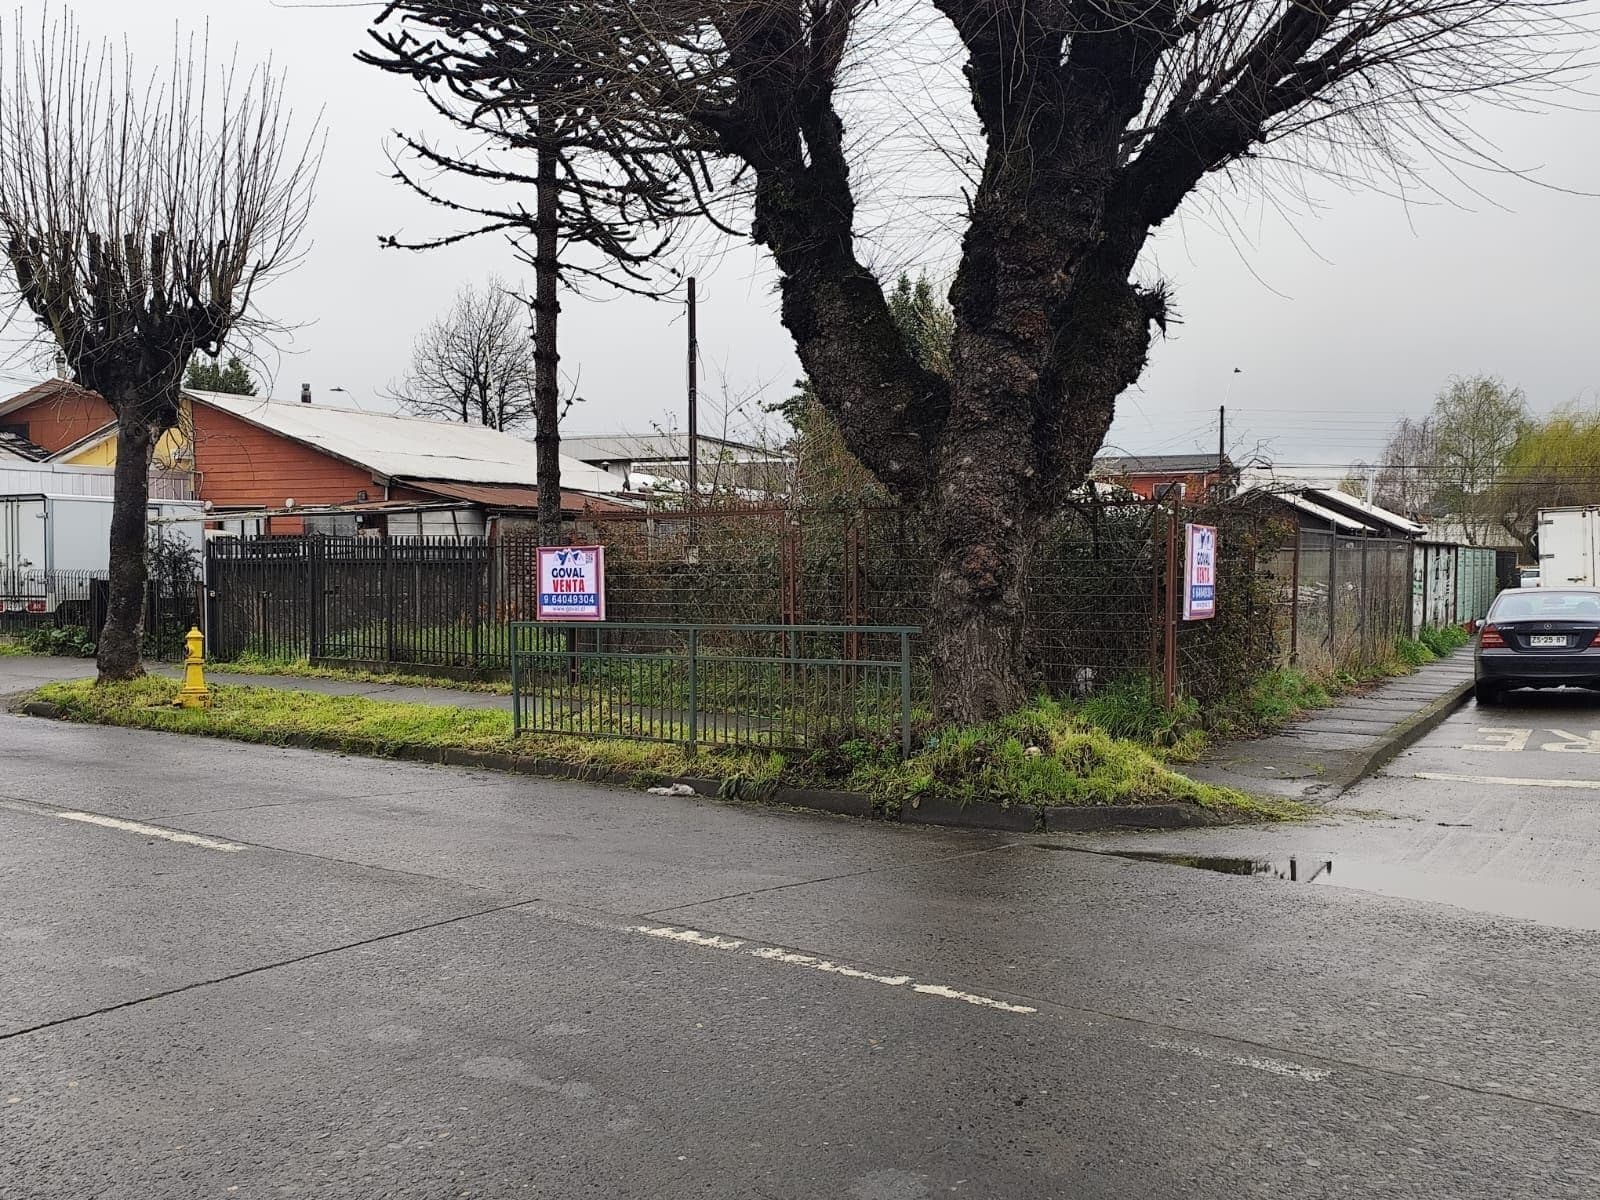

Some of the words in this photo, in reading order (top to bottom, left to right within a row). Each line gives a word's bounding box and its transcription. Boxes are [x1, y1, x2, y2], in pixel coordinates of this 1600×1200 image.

[551, 568, 585, 578] GOVAL
[552, 579, 585, 592] VENTA
[543, 595, 549, 604] 9
[551, 594, 594, 604] 64049304
